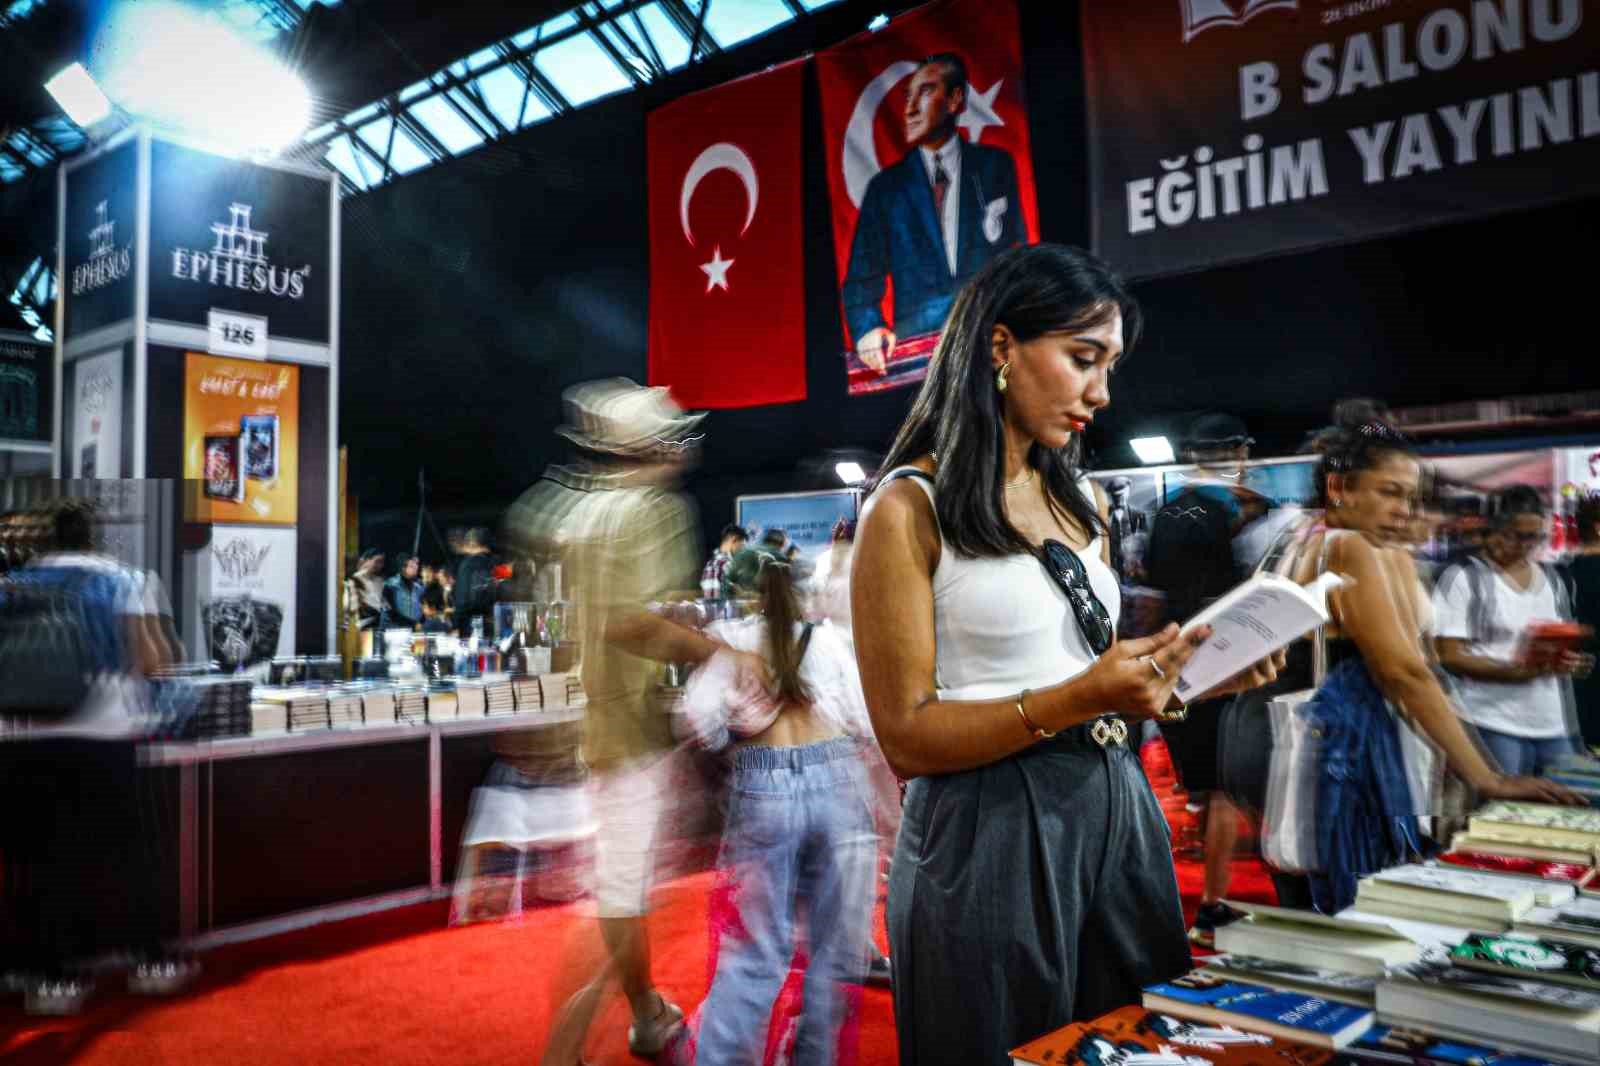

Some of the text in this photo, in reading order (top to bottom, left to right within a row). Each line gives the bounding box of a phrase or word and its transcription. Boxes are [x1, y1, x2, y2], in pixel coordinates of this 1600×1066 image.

[1238, 0, 1583, 120] B SALONU
[1126, 133, 1329, 234] EĞİTİM
[171, 246, 305, 299] EPHESUS
